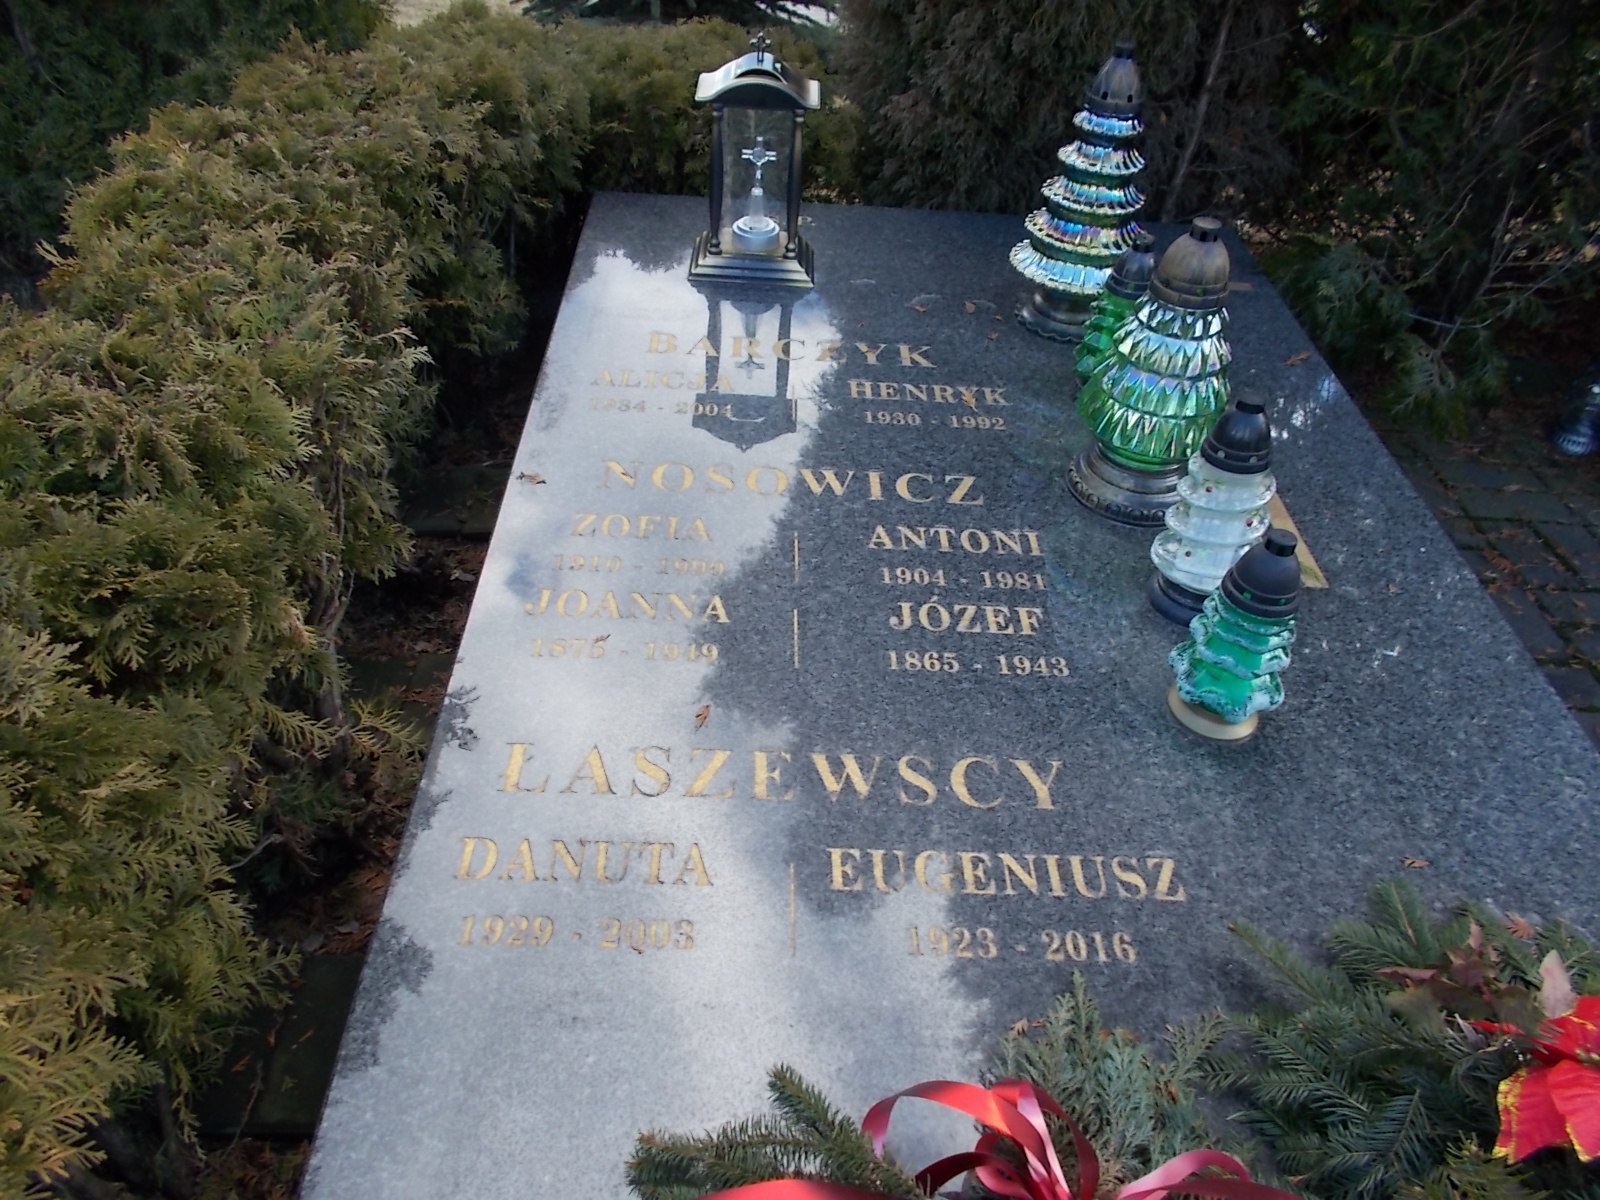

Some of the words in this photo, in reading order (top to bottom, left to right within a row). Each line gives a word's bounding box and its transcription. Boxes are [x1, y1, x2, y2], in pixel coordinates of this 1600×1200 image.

[646, 331, 936, 368] BARCZYK
[591, 367, 734, 392] ALICJA
[847, 378, 1013, 406] HENRYK
[674, 400, 735, 418] 2004
[865, 410, 922, 427] 1930
[950, 414, 1007, 431] 1992
[600, 459, 985, 506] NOSOWICZ
[571, 511, 713, 541] ZOFIA
[868, 523, 1043, 557] ANTONI
[880, 566, 946, 587] 1904
[980, 569, 1048, 592] 1981
[523, 587, 730, 624] JOANNA
[889, 596, 1044, 637] JÓZEF
[888, 649, 960, 674] 1865
[998, 653, 1071, 678] 1943
[497, 741, 1063, 811] ŁASZEWSCY
[453, 836, 714, 887] DANUTA
[827, 846, 1187, 902] EUGENIUSZ
[458, 913, 555, 947] 1929
[599, 916, 695, 949] 2003
[907, 924, 998, 960] 1923
[1045, 928, 1137, 965] 2016
